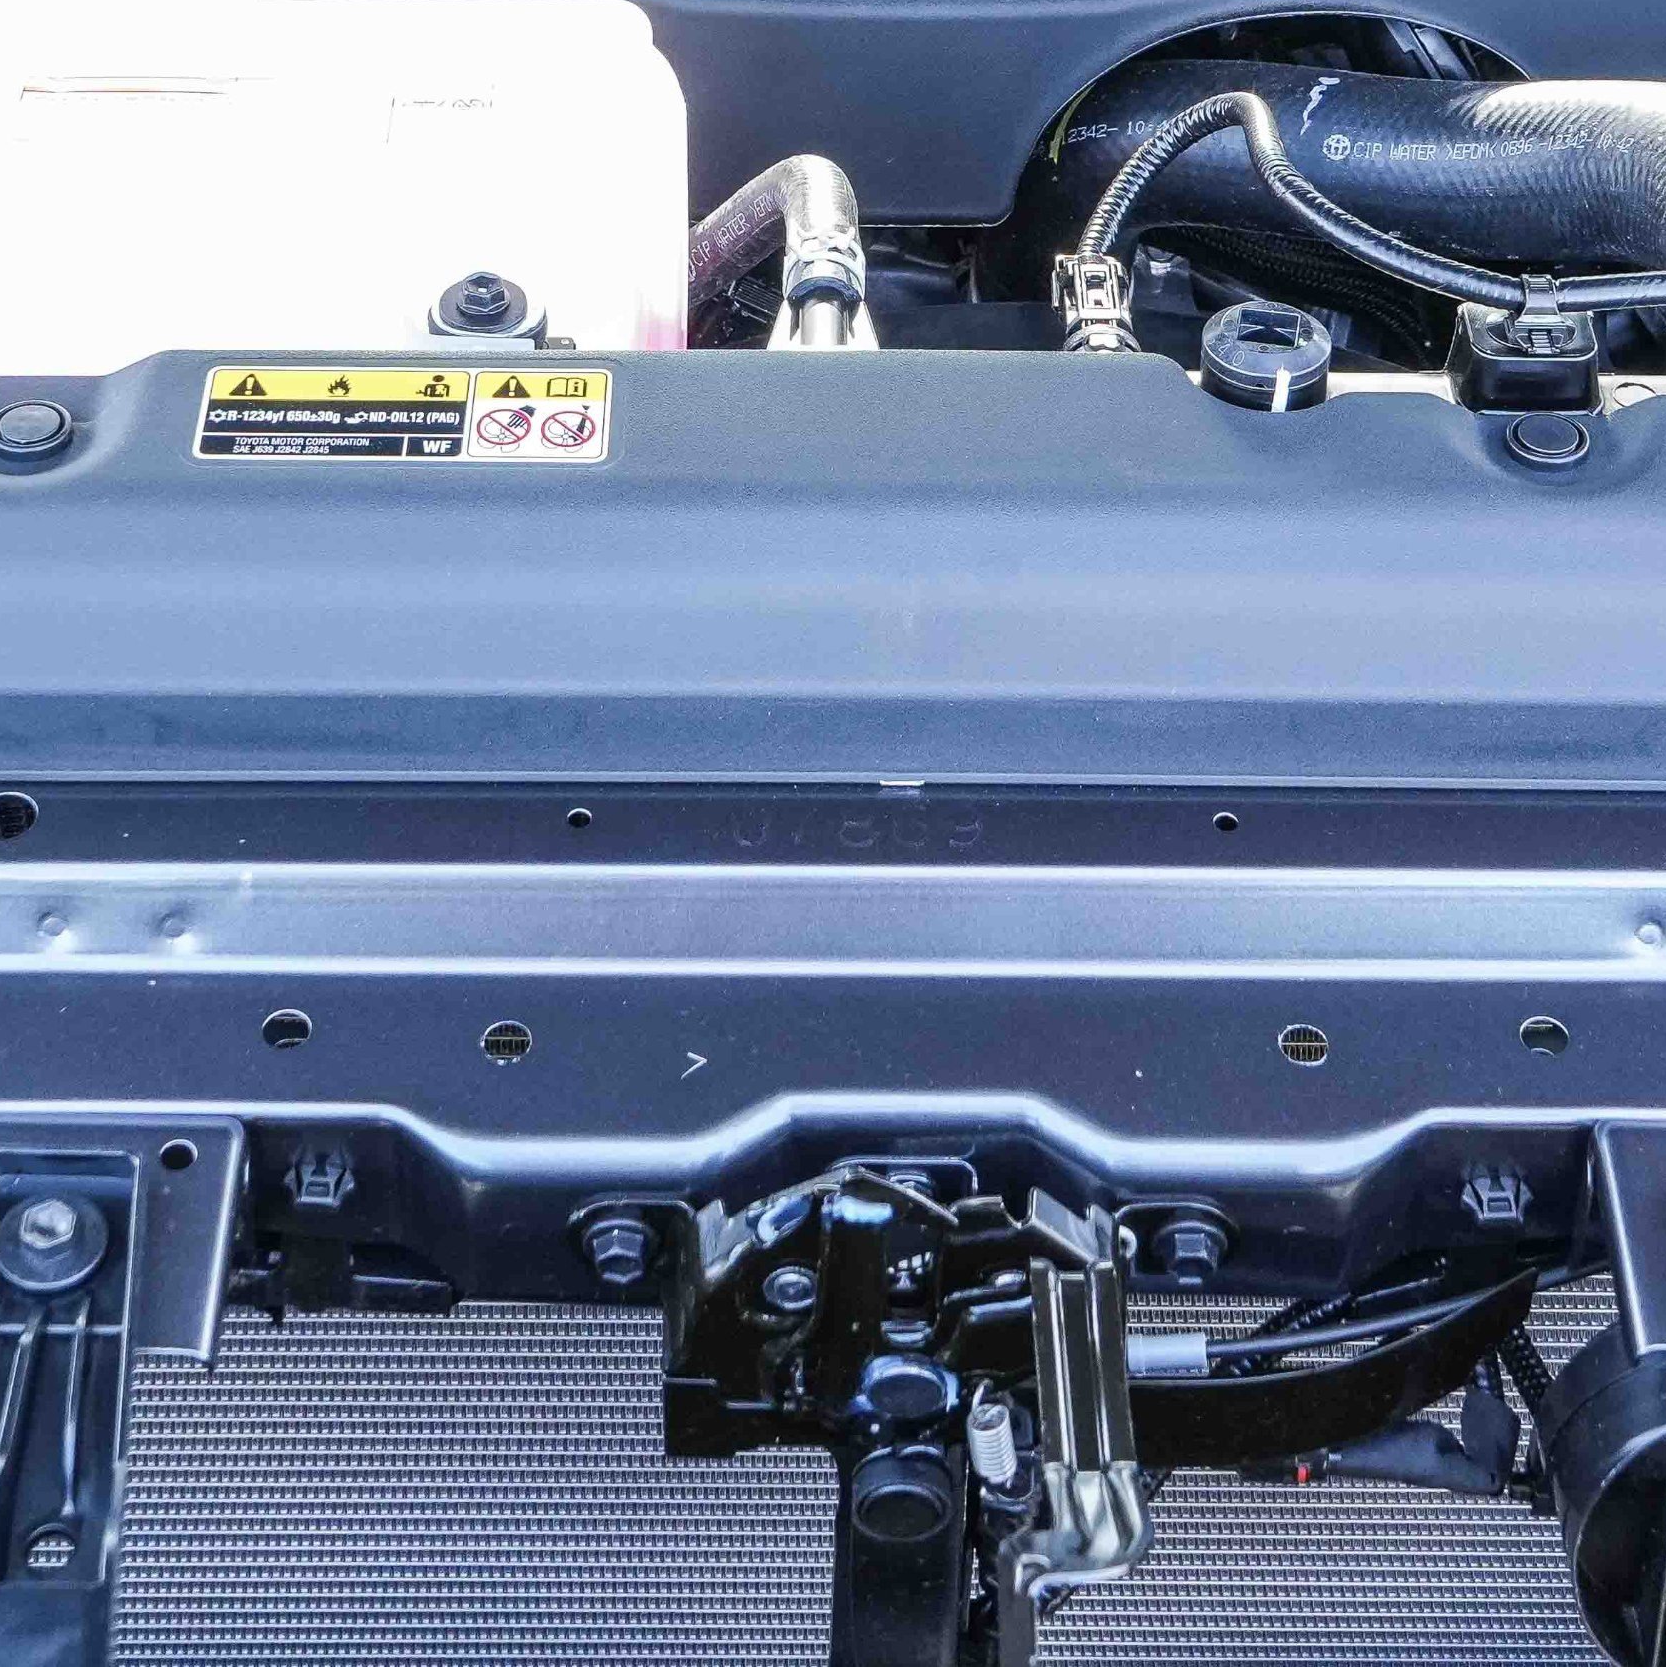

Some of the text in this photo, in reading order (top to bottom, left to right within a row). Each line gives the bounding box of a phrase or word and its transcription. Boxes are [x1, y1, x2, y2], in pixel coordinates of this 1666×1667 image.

[1389, 142, 1437, 161] WATER
[713, 212, 752, 249] WATER
[227, 410, 460, 425] R-1234yf 650±30g ND-OIL12 (PAG)
[235, 437, 370, 446] TOYOTA MOTOR CORPORATION
[423, 440, 452, 453] WF
[233, 445, 330, 454] SAE J639 J2842 J2845
